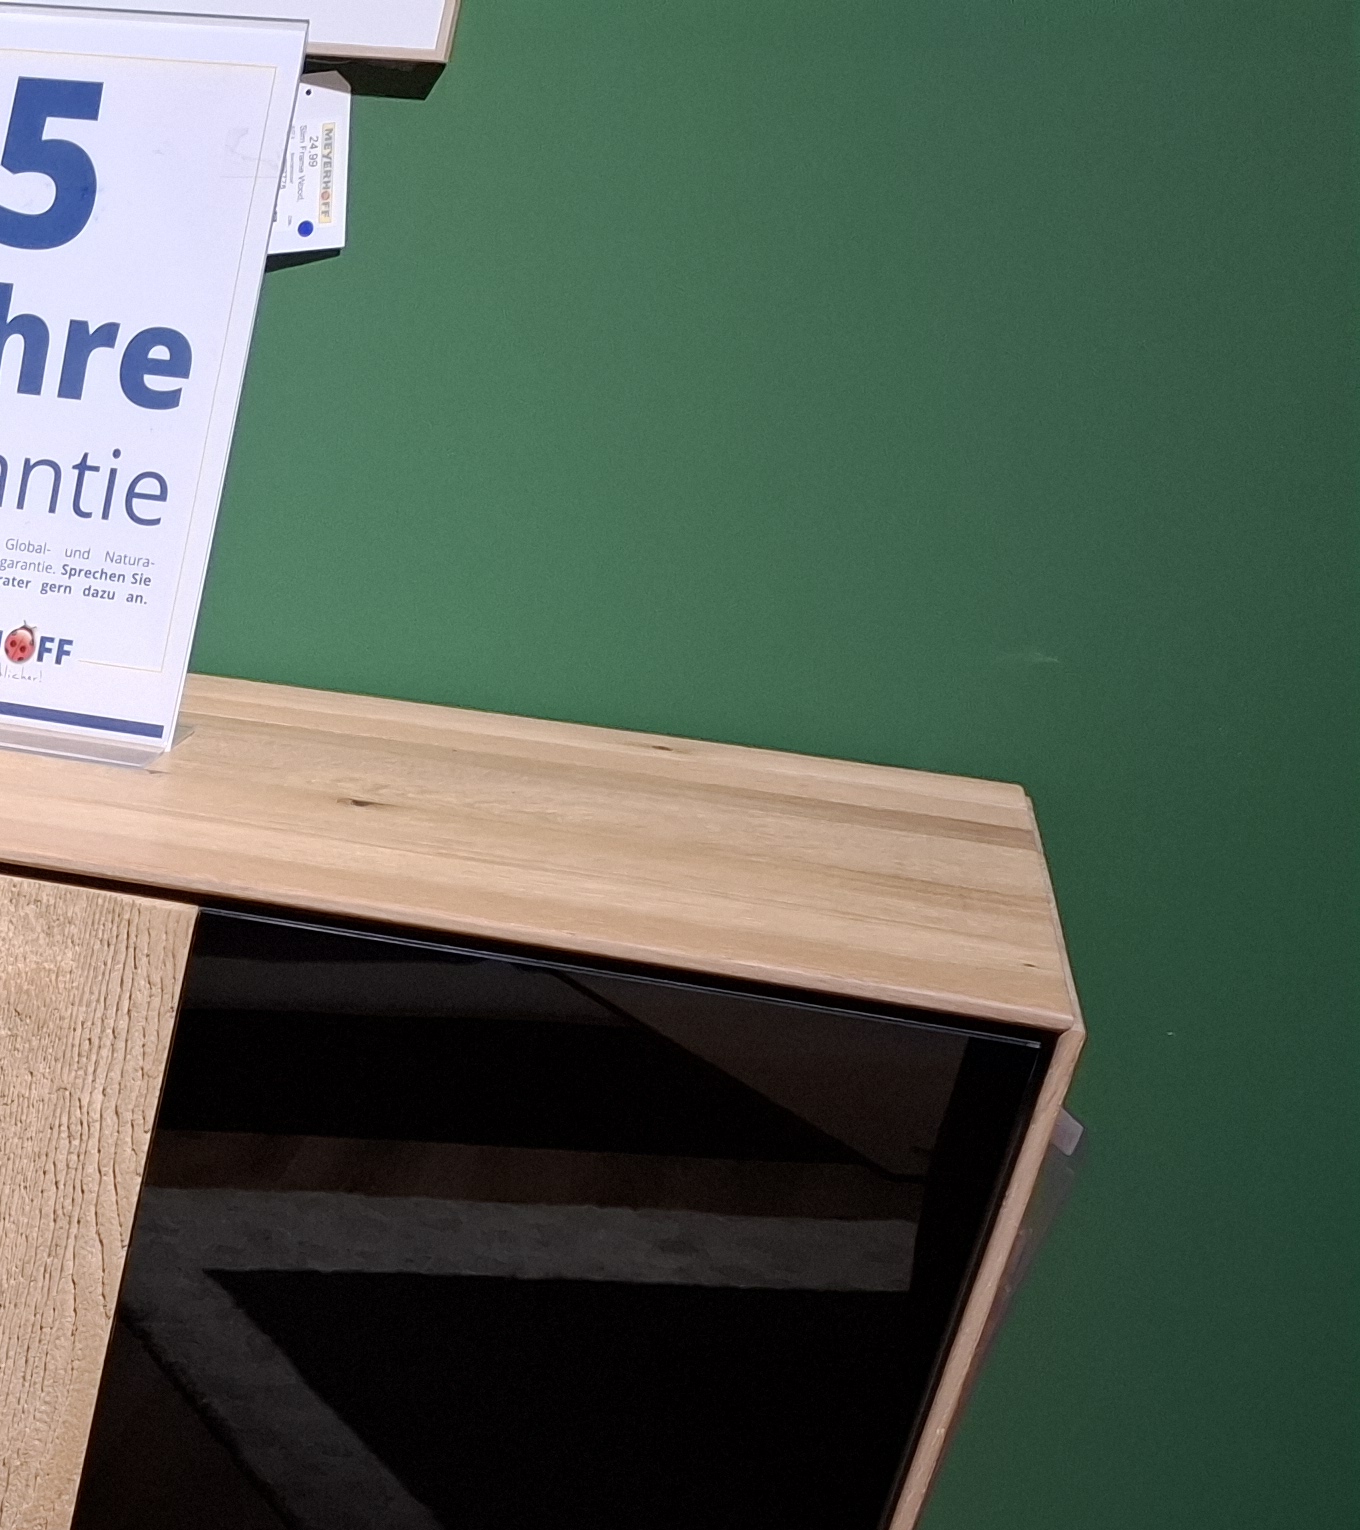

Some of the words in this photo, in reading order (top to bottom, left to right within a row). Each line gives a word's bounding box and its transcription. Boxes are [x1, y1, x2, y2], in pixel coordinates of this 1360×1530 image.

[308, 136, 319, 168] 24.99
[5, 537, 52, 555] Global-
[64, 547, 91, 560] und
[104, 550, 156, 568] Natura-
[60, 563, 126, 584] Sprechen
[130, 572, 152, 587] Sie
[40, 581, 72, 596] gern
[82, 584, 116, 601] dazu
[125, 592, 148, 605] an.
